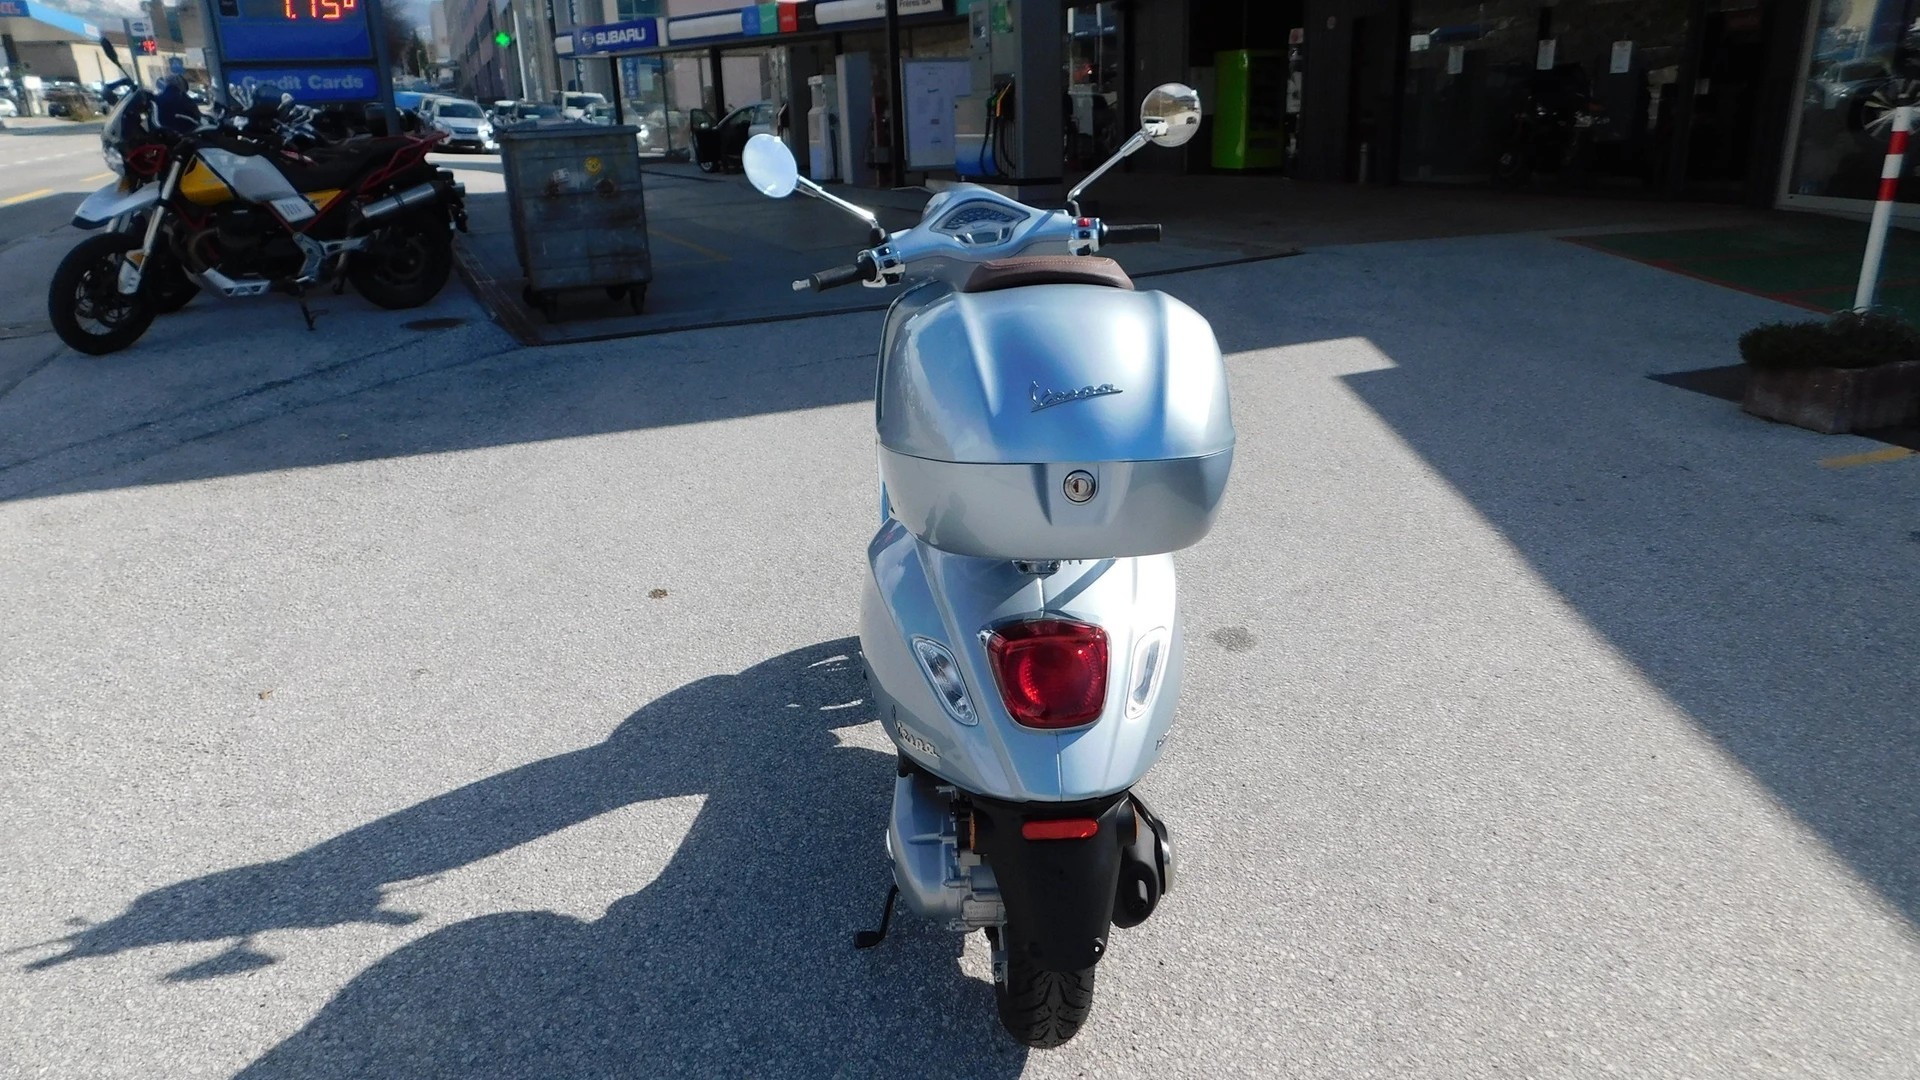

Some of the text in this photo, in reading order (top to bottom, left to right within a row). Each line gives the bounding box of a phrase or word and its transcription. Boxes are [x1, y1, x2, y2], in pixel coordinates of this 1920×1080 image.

[595, 27, 646, 46] SUBARU
[308, 75, 364, 90] Cards
[1029, 380, 1123, 413] Vespa
